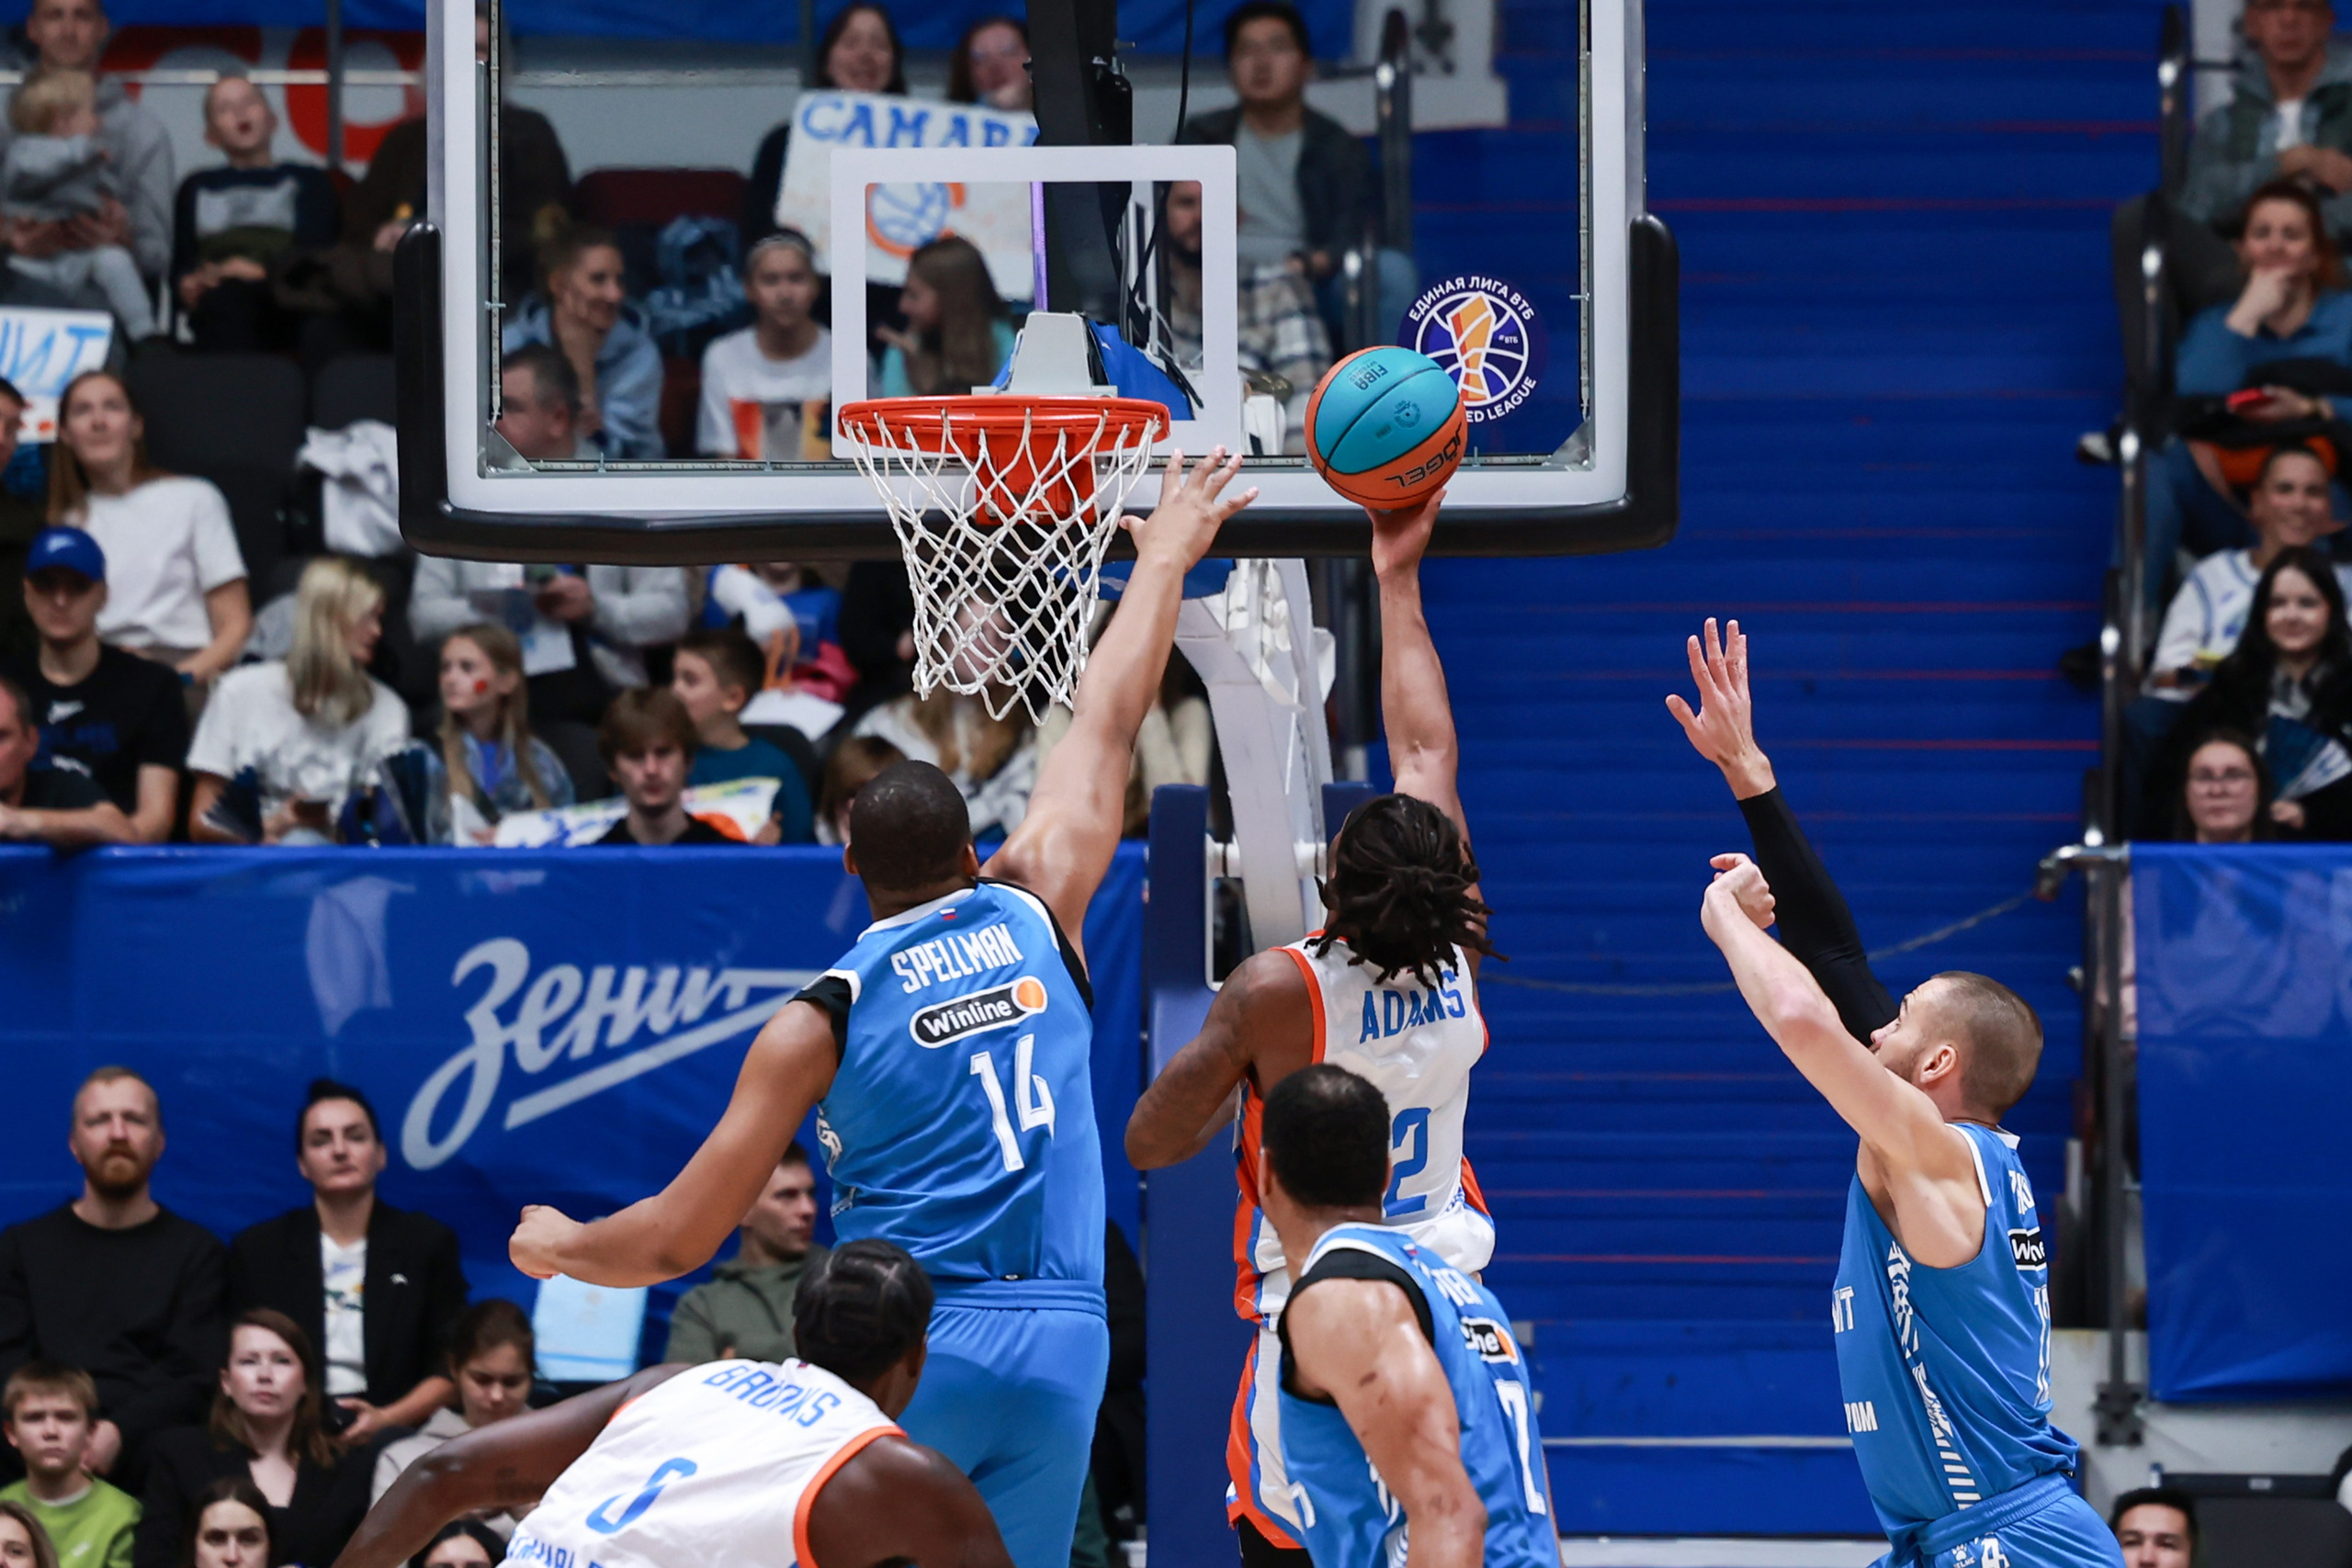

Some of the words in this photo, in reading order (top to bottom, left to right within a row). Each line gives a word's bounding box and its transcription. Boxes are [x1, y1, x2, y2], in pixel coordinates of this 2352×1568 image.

[1408, 277, 1465, 321] ЕДИНАЯ
[1469, 276, 1509, 298] ЛИГА
[1510, 292, 1535, 321] ВТБ
[1353, 364, 1389, 391] FIBA
[1487, 376, 1537, 421] LEAGUE
[890, 922, 1024, 995] SPELLMAN
[922, 999, 1013, 1038] Winline
[1359, 969, 1466, 1044] ADAMS
[969, 1032, 1056, 1172] 14
